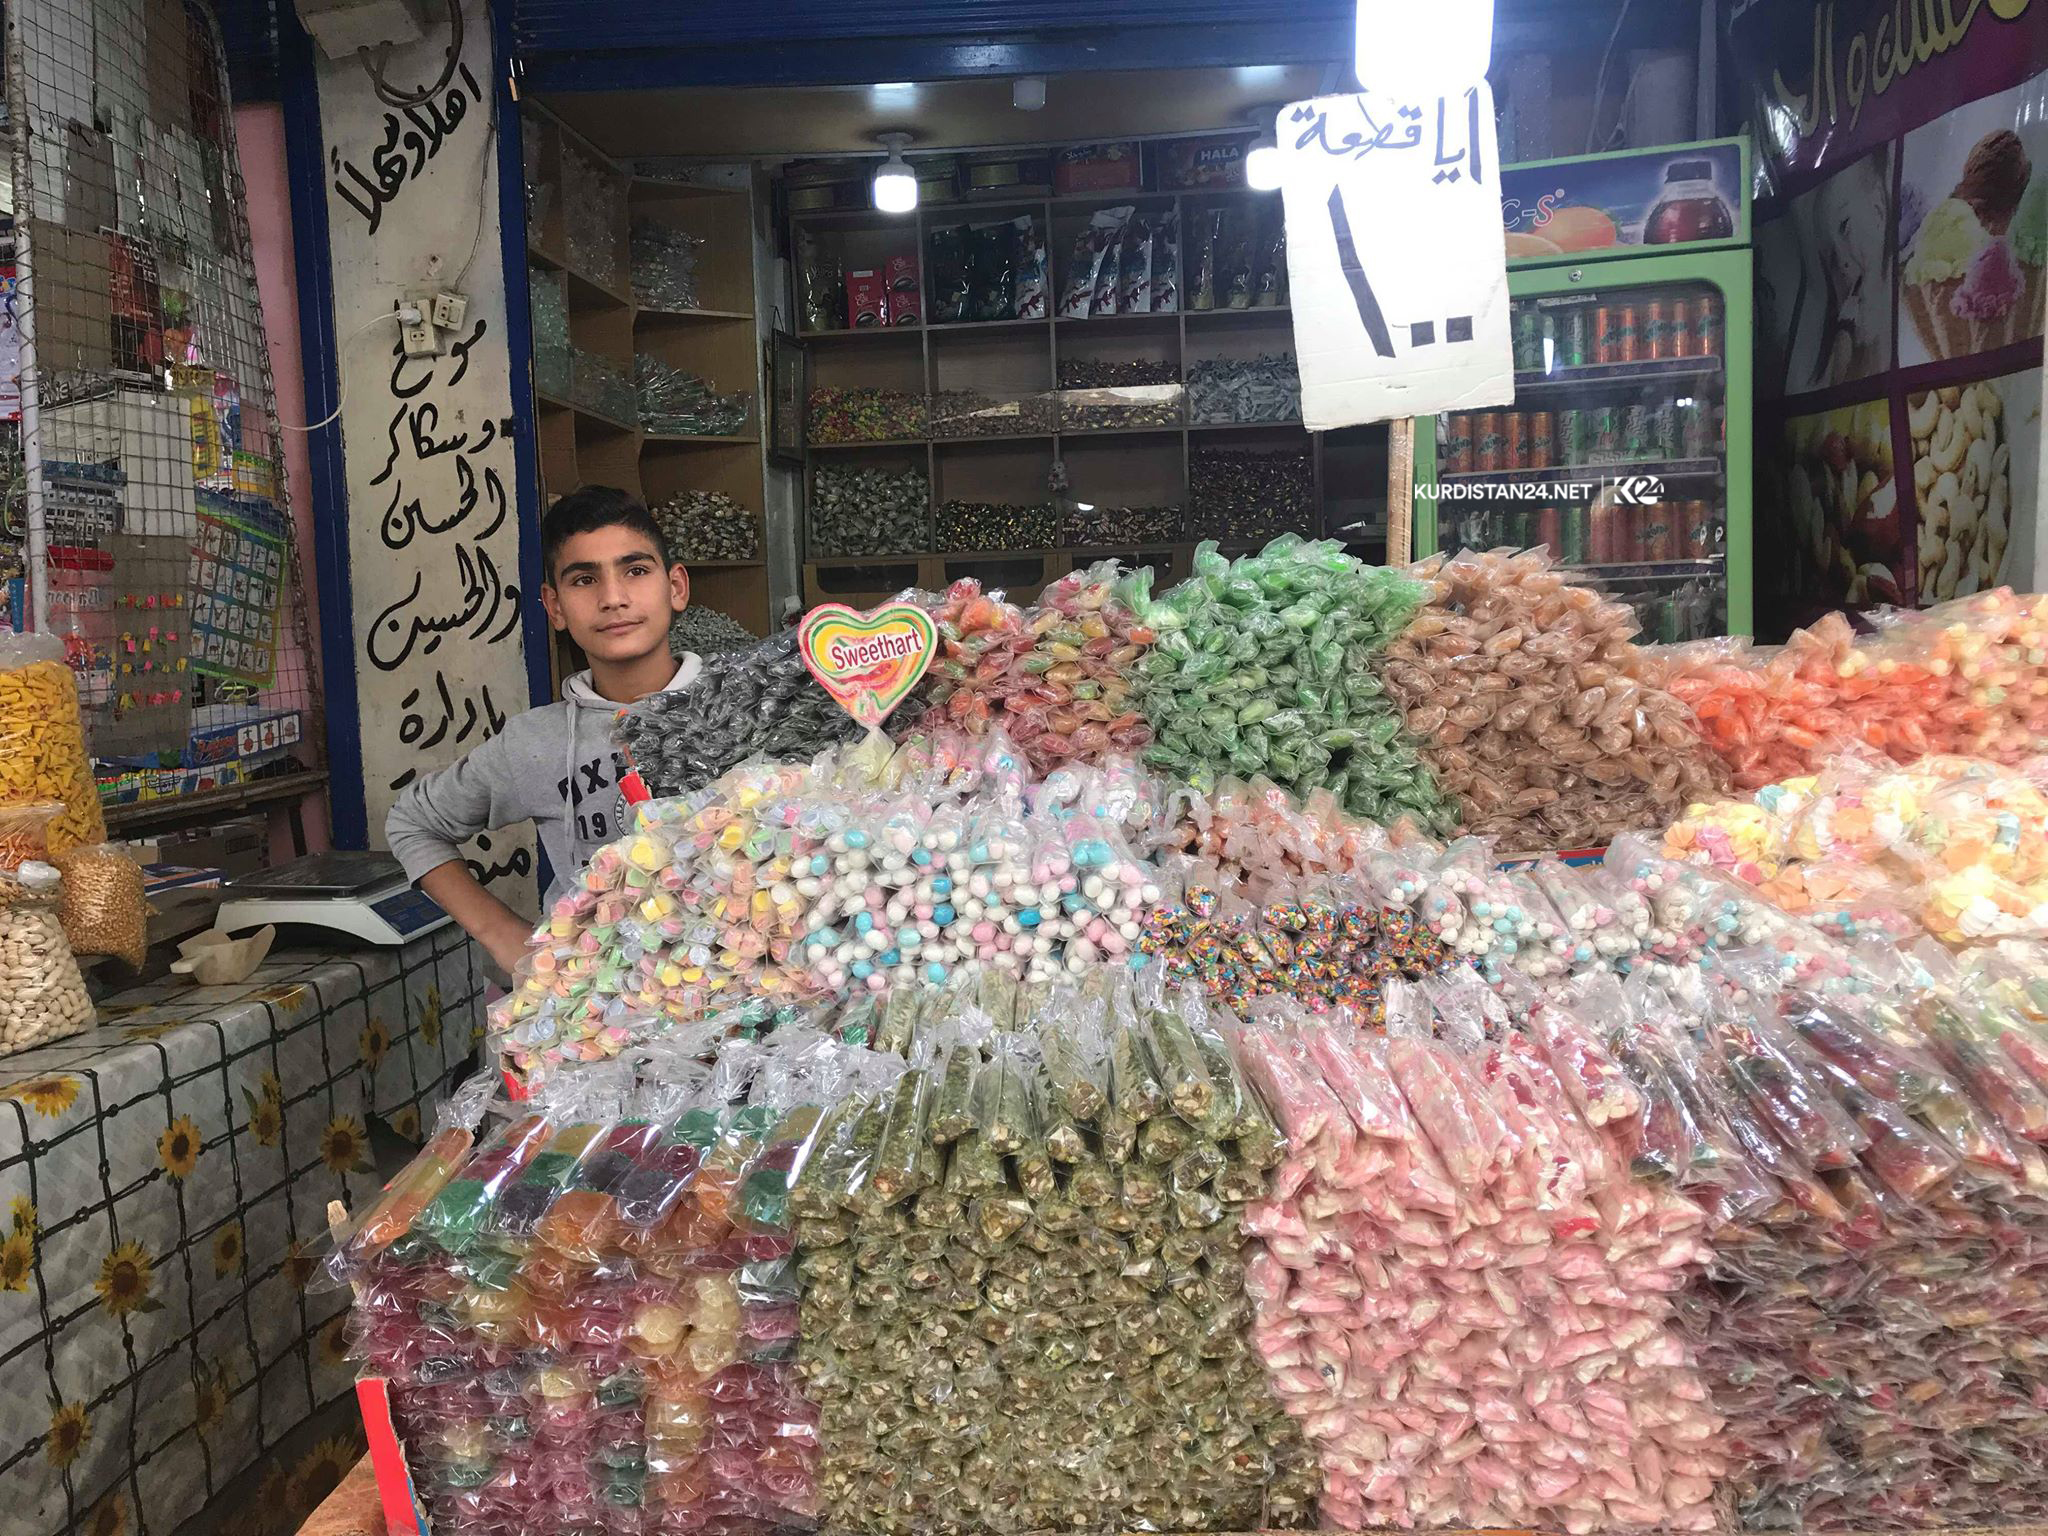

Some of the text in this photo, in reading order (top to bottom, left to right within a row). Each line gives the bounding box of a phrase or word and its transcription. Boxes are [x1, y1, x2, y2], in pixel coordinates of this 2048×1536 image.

[1201, 147, 1239, 161] HALA
[367, 542, 521, 671] والحسين
[832, 628, 922, 670] Sweethart
[578, 812, 607, 840] 19
